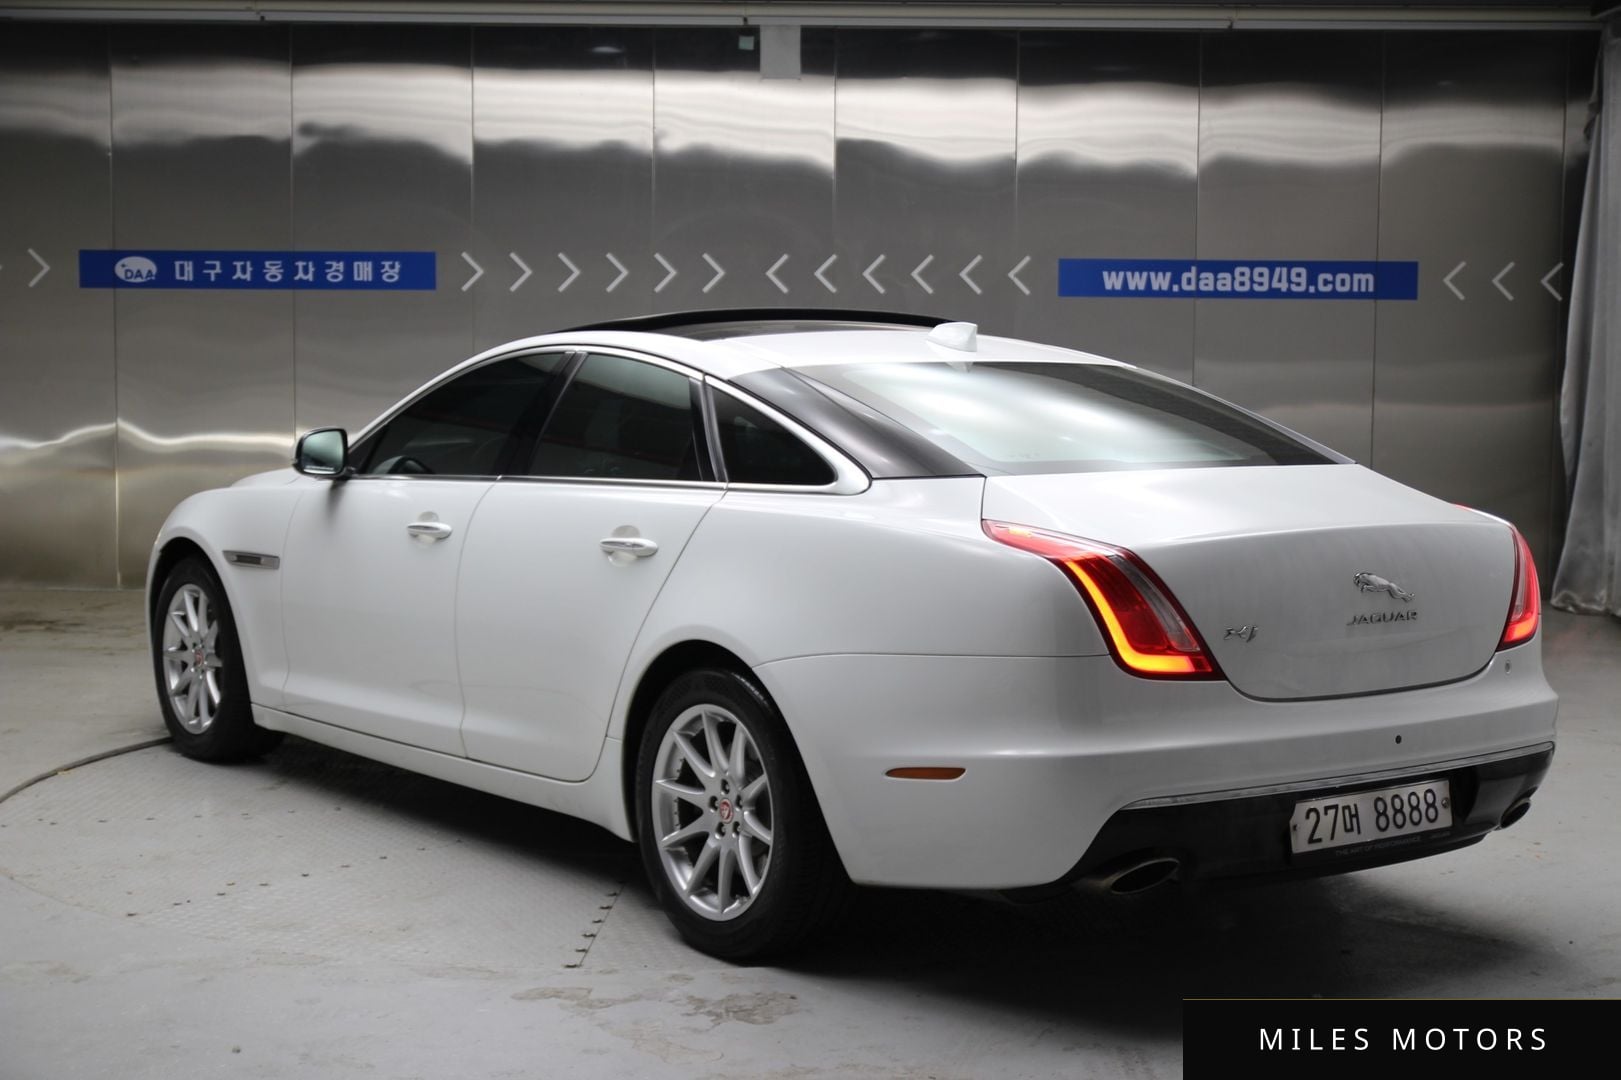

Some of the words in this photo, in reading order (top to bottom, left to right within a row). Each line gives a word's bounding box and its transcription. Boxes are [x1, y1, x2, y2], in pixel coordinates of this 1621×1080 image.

[124, 268, 155, 281] DAA
[1102, 265, 1375, 294] www.daa8949.com
[1346, 610, 1418, 627] JAGUAR
[1305, 803, 1361, 844] 27머
[1373, 788, 1439, 832] 8888
